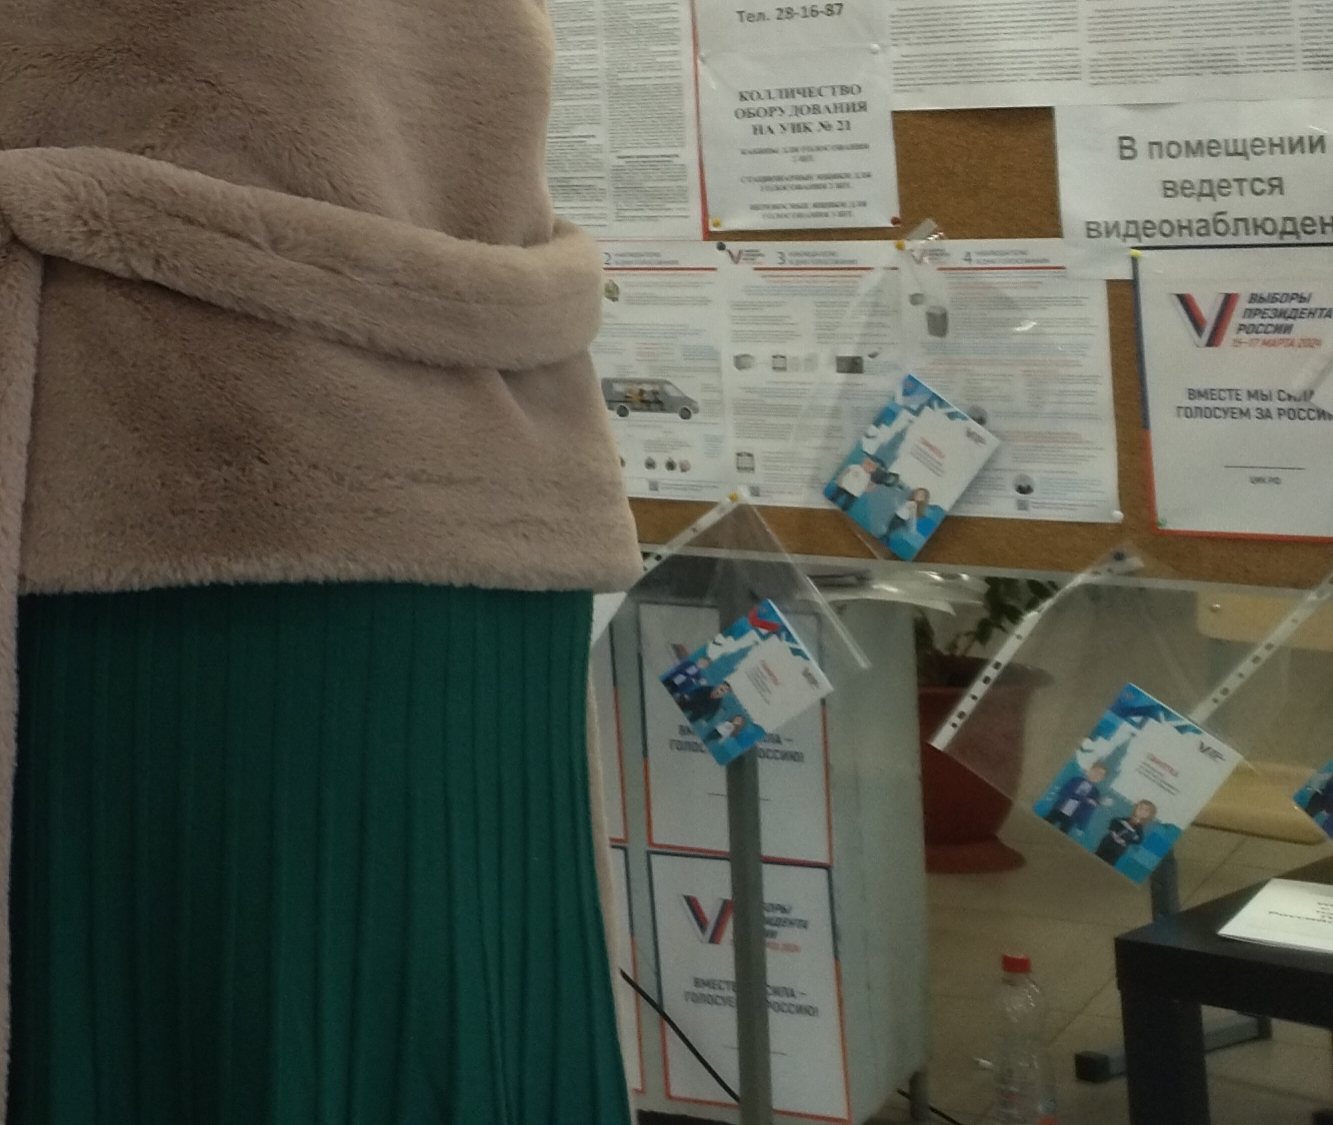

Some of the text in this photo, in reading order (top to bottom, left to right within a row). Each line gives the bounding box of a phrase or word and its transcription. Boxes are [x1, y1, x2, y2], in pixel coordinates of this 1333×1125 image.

[735, 10, 771, 24] Тел.
[734, 100, 868, 121] ОБОРУДОВАНИЯ
[752, 122, 775, 136] НА
[780, 121, 814, 135] УИК
[836, 119, 852, 132] 21
[1118, 134, 1327, 161] В помещении
[1162, 176, 1285, 202] ведется
[1247, 292, 1313, 304] ВЫБОРЫ
[1241, 307, 1333, 322] ПРЕЗИДЕНТА
[1236, 323, 1294, 335] РОССИИ
[1187, 387, 1243, 402] ВМЕСТЕ
[1246, 389, 1274, 403] МЫ
[1176, 405, 1252, 421] ГОЛОСУЕМ
[1254, 407, 1274, 421] ЗА
